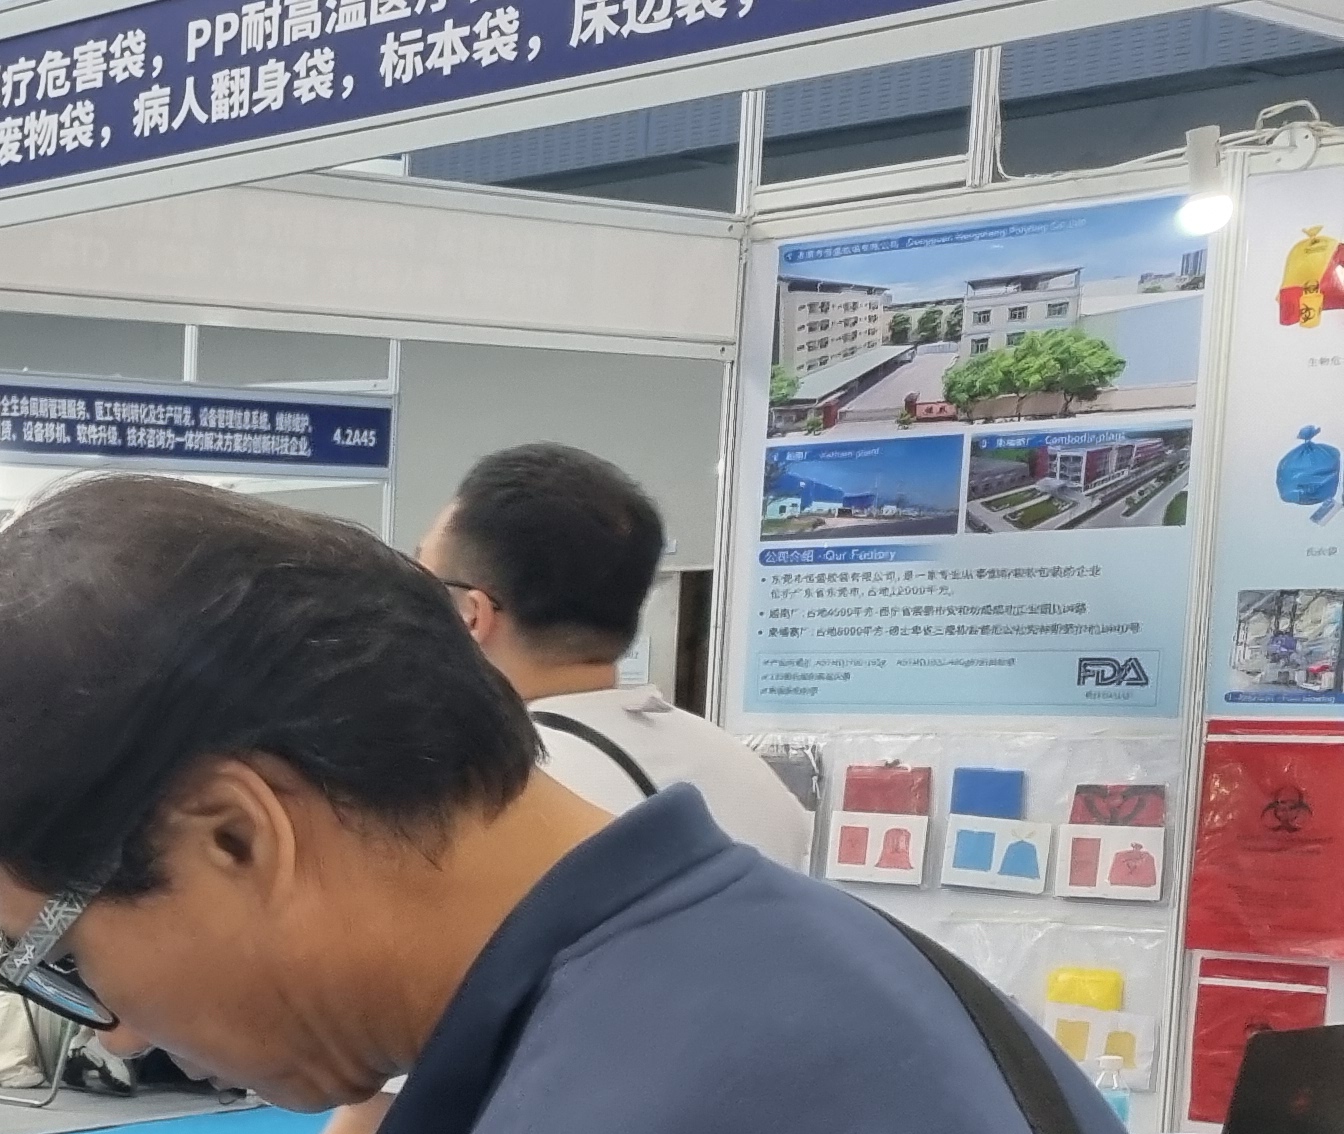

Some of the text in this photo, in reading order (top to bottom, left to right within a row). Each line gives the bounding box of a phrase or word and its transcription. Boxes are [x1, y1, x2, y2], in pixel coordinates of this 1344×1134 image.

[332, 427, 377, 448] 4.2A45
[825, 550, 847, 562] Our
[1077, 657, 1149, 686] FDA
